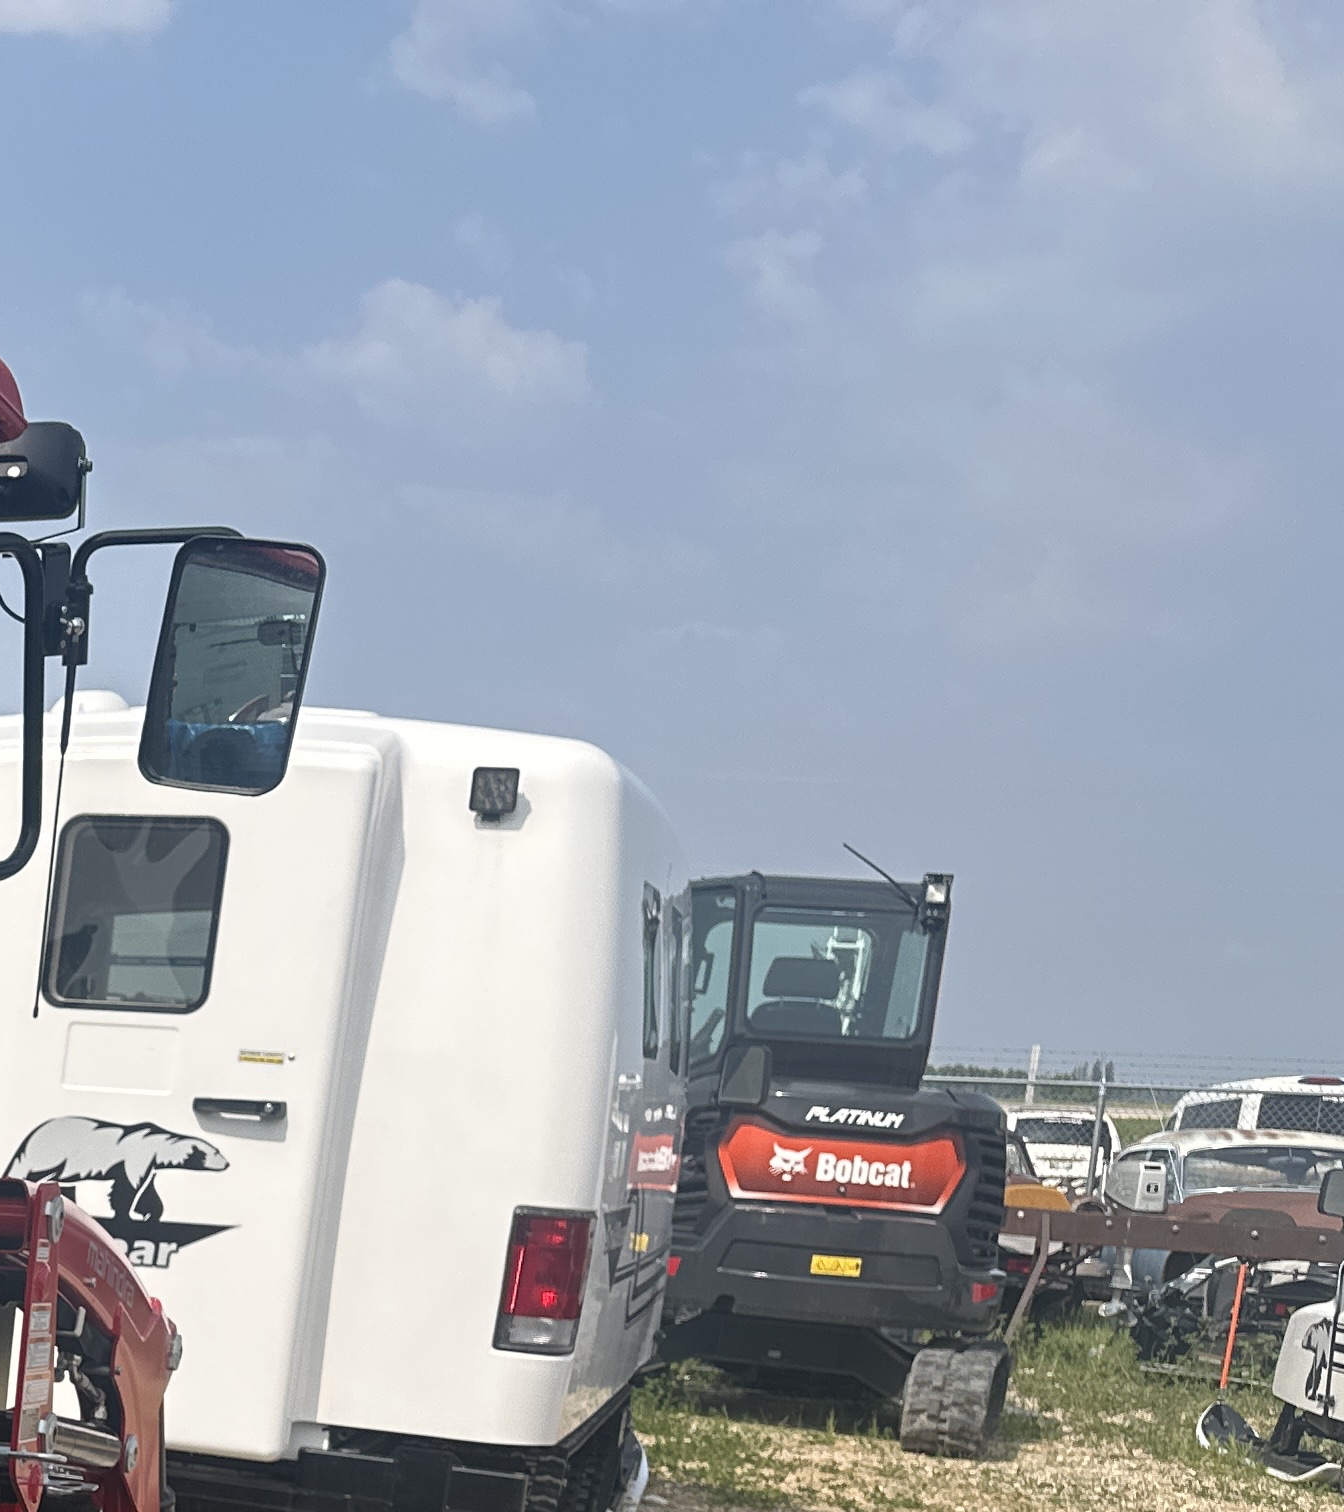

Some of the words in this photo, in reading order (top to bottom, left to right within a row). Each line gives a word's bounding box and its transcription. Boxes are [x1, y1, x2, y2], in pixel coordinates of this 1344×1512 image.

[805, 1105, 905, 1129] PLATINUM
[815, 1152, 912, 1189] Bobcat
[110, 1236, 179, 1269] ear
[86, 1240, 136, 1309] mahindra
